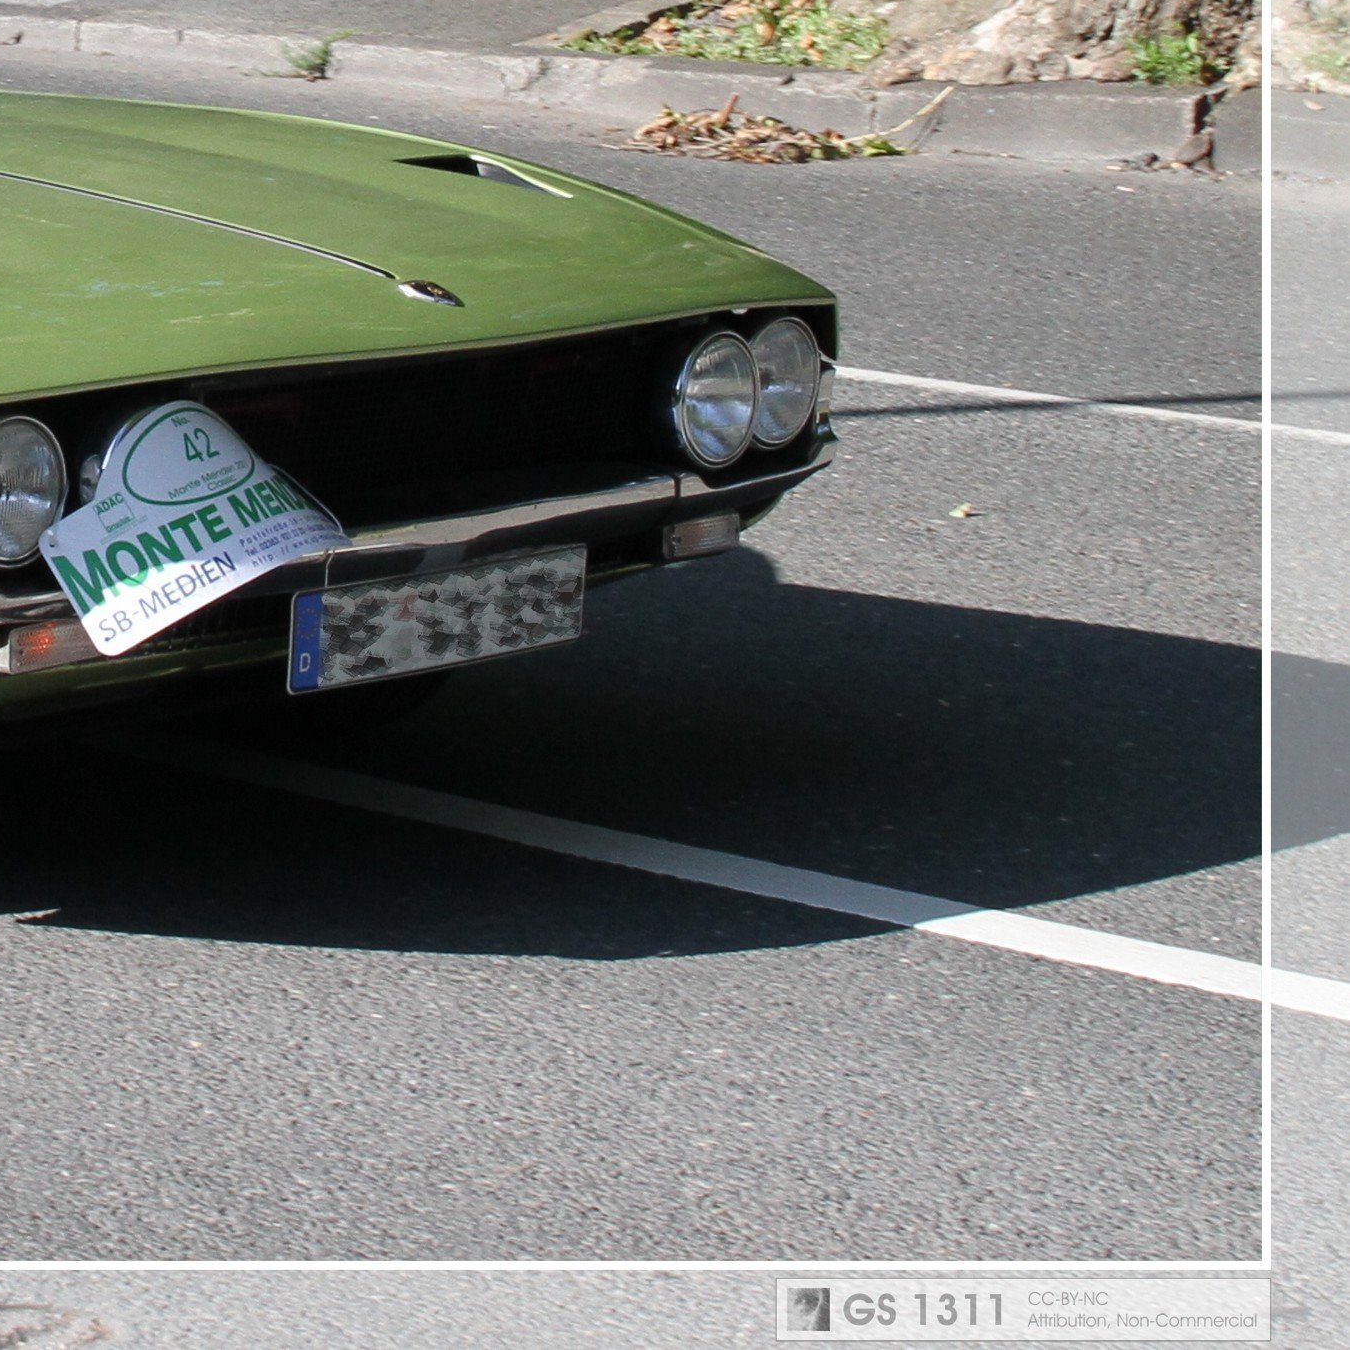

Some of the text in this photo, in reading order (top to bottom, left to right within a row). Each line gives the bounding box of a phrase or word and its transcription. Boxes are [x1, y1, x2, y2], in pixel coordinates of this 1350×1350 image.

[183, 427, 220, 462] 42
[96, 492, 125, 515] ADAC
[167, 479, 201, 500] Monte
[50, 504, 233, 615] MONTE
[98, 550, 238, 644] SB-MEDIEN
[299, 652, 311, 673] D
